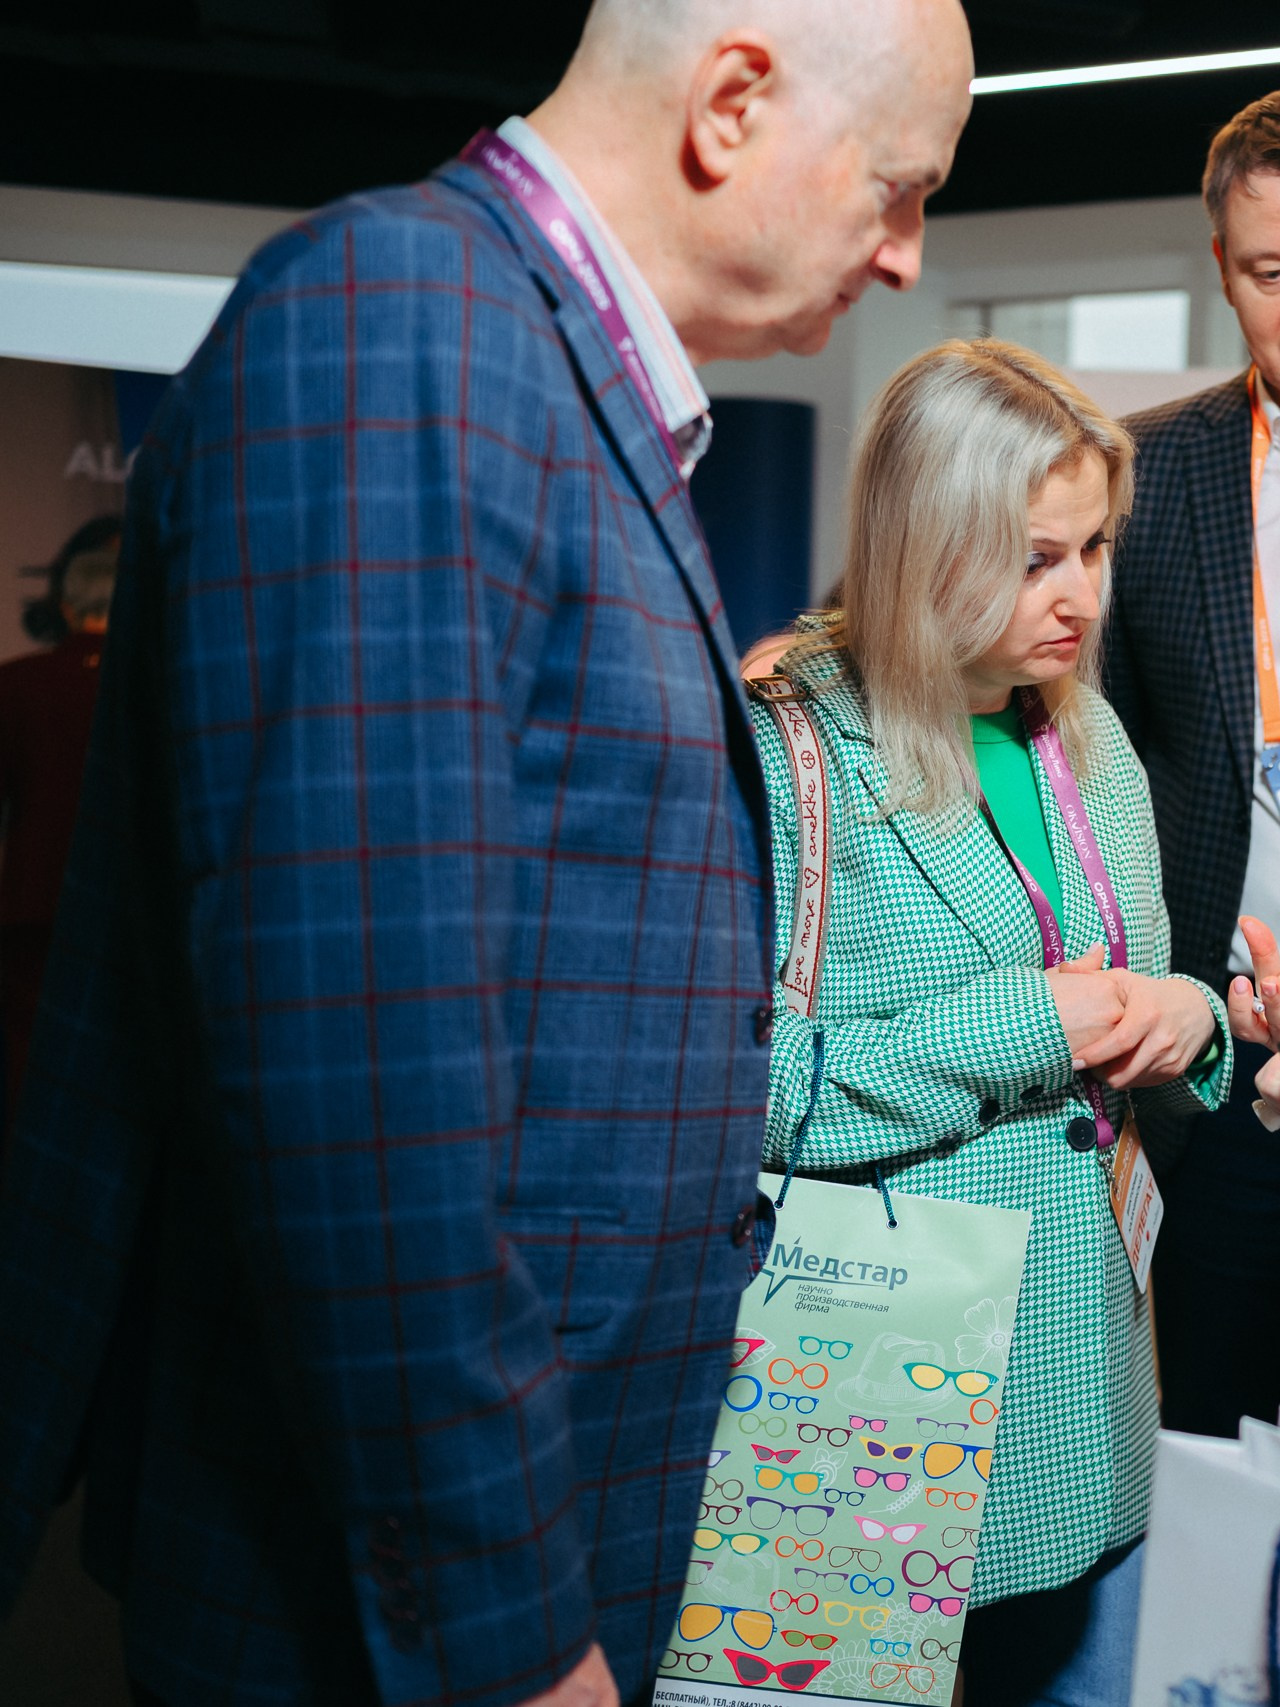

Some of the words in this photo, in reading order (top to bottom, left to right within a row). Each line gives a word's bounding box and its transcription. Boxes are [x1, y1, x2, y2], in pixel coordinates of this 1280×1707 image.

[1066, 803, 1092, 859] OKVISION
[1093, 882, 1120, 944] ОРЧ-2025
[1132, 1178, 1156, 1271] ДЕЛЕГАТ
[772, 1242, 908, 1290] Медстар
[797, 1283, 833, 1296] научно
[794, 1301, 830, 1314] фирма
[796, 1291, 890, 1313] производственная
